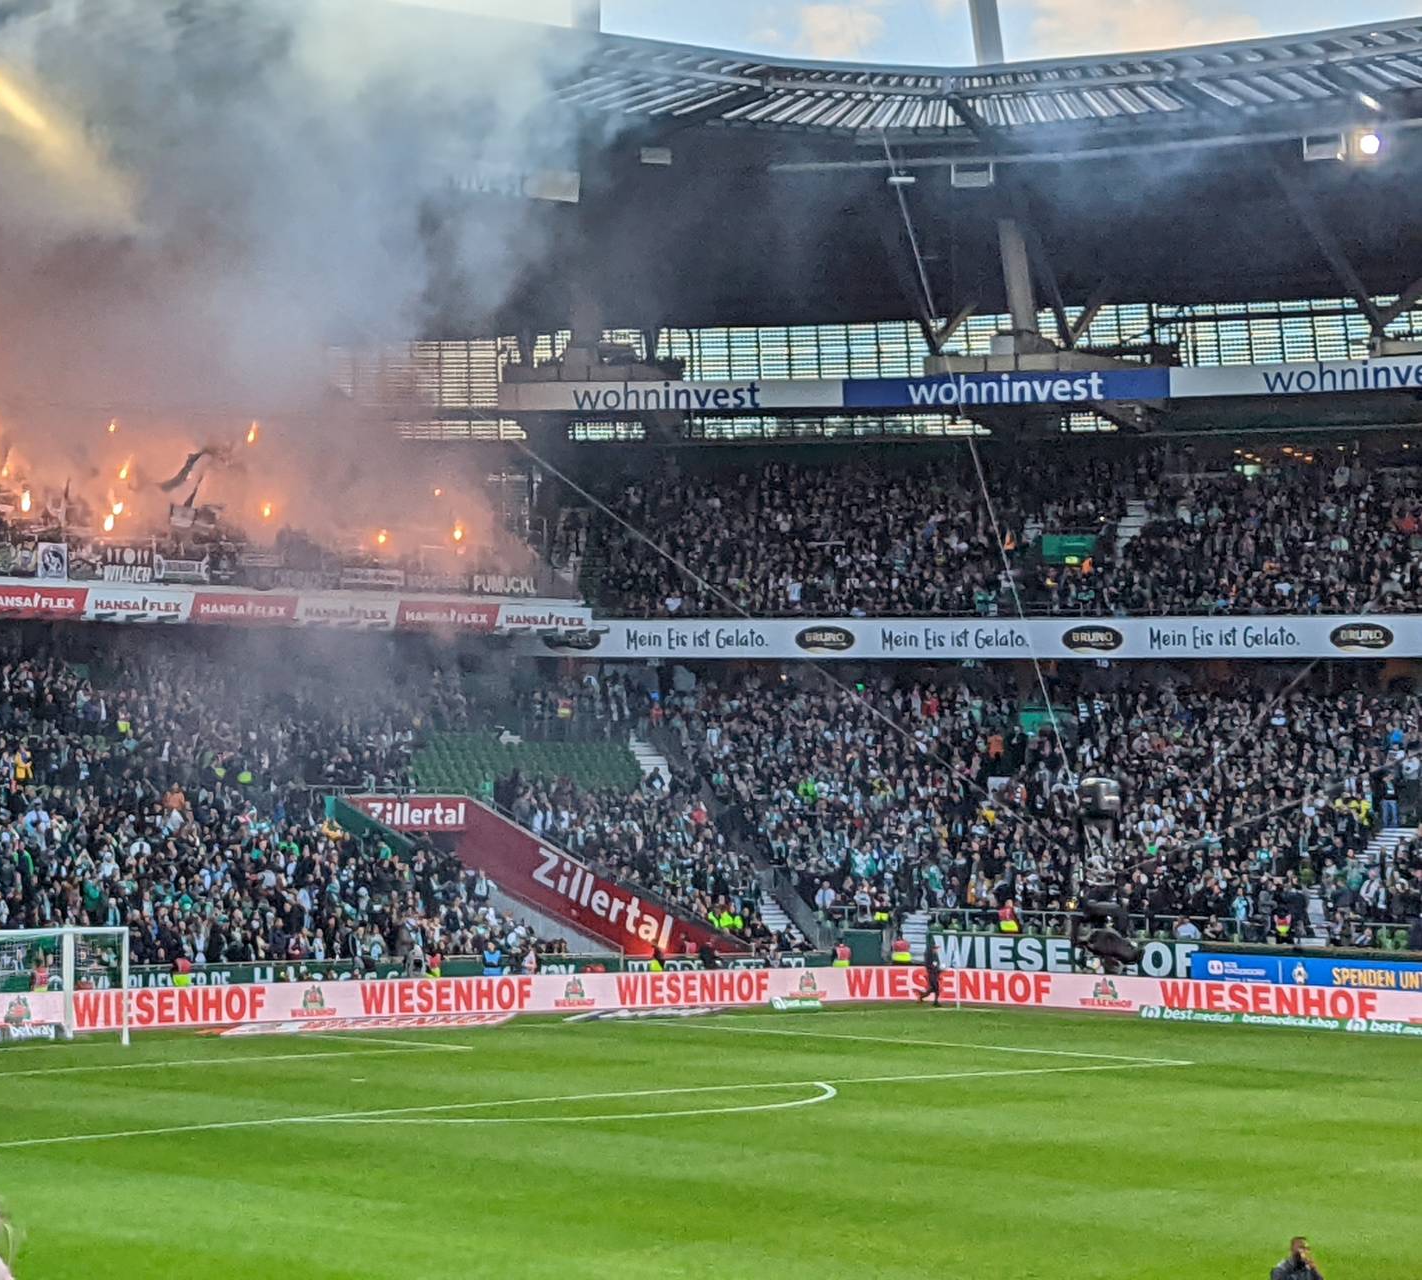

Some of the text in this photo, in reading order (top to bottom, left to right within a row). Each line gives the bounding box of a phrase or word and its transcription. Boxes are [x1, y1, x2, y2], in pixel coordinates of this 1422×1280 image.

[573, 381, 761, 410] wohninvest
[908, 372, 1103, 405] wohninvest
[626, 626, 769, 651] Mein Eis ist Gelato.
[805, 632, 846, 642] BRUNO
[881, 626, 1030, 651] Mein Eis ist Gelato.
[1072, 632, 1114, 642] BRUNO
[1150, 625, 1300, 650] Mein Eis ist Gelato.
[1340, 629, 1383, 641] BRUNO
[367, 802, 466, 826] Zillertal
[532, 846, 674, 950] Zillertal
[932, 934, 1199, 978] WIESEOF
[616, 970, 770, 1006] WIESENHOF
[1332, 967, 1396, 988] SPENDEN
[73, 985, 266, 1028] WIESENHOF
[361, 976, 532, 1015] WIESENHOF
[1159, 981, 1378, 1019] WIESENHOF
